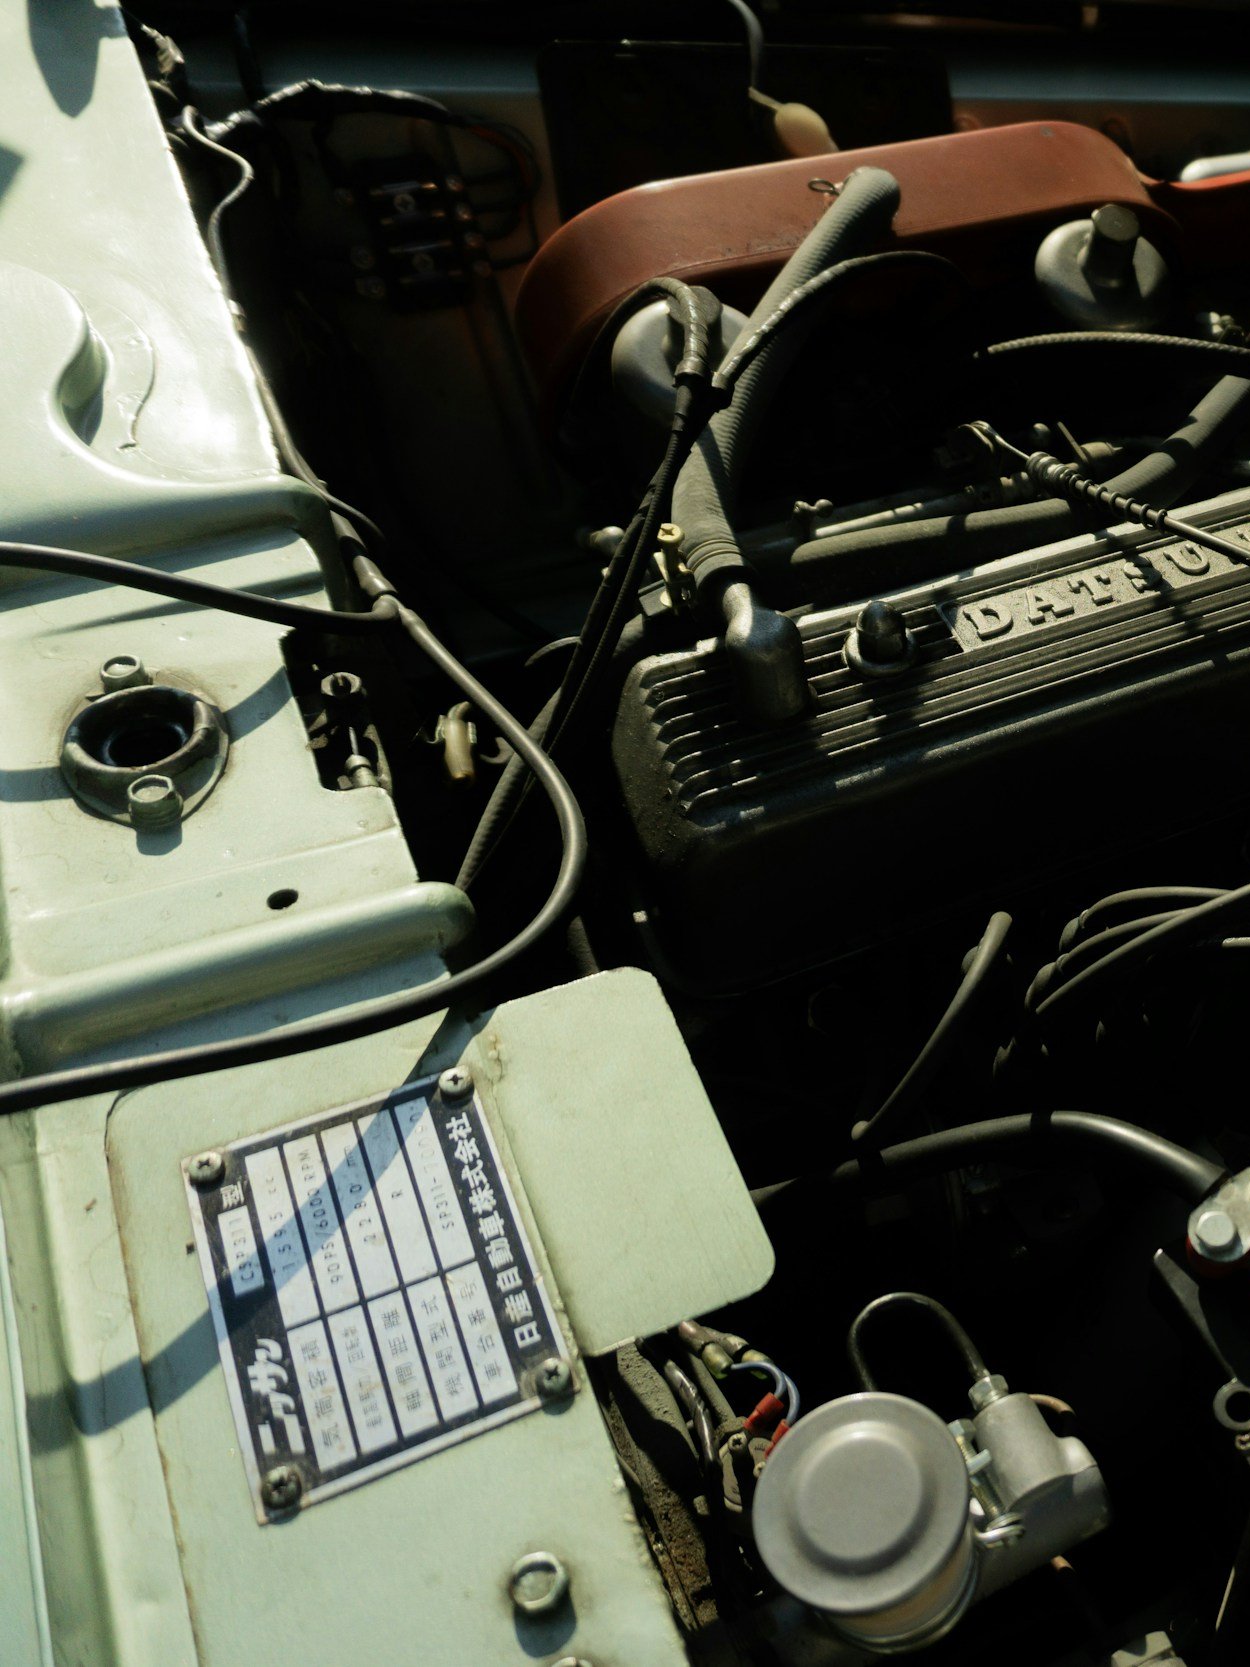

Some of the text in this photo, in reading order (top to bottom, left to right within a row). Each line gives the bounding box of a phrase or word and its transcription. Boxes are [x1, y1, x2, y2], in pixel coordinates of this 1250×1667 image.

[390, 1188, 404, 1199] R
[446, 1112, 542, 1349] 日産自動車株式会社
[227, 1216, 255, 1282] CSP311
[246, 1338, 305, 1455] ニッサン
